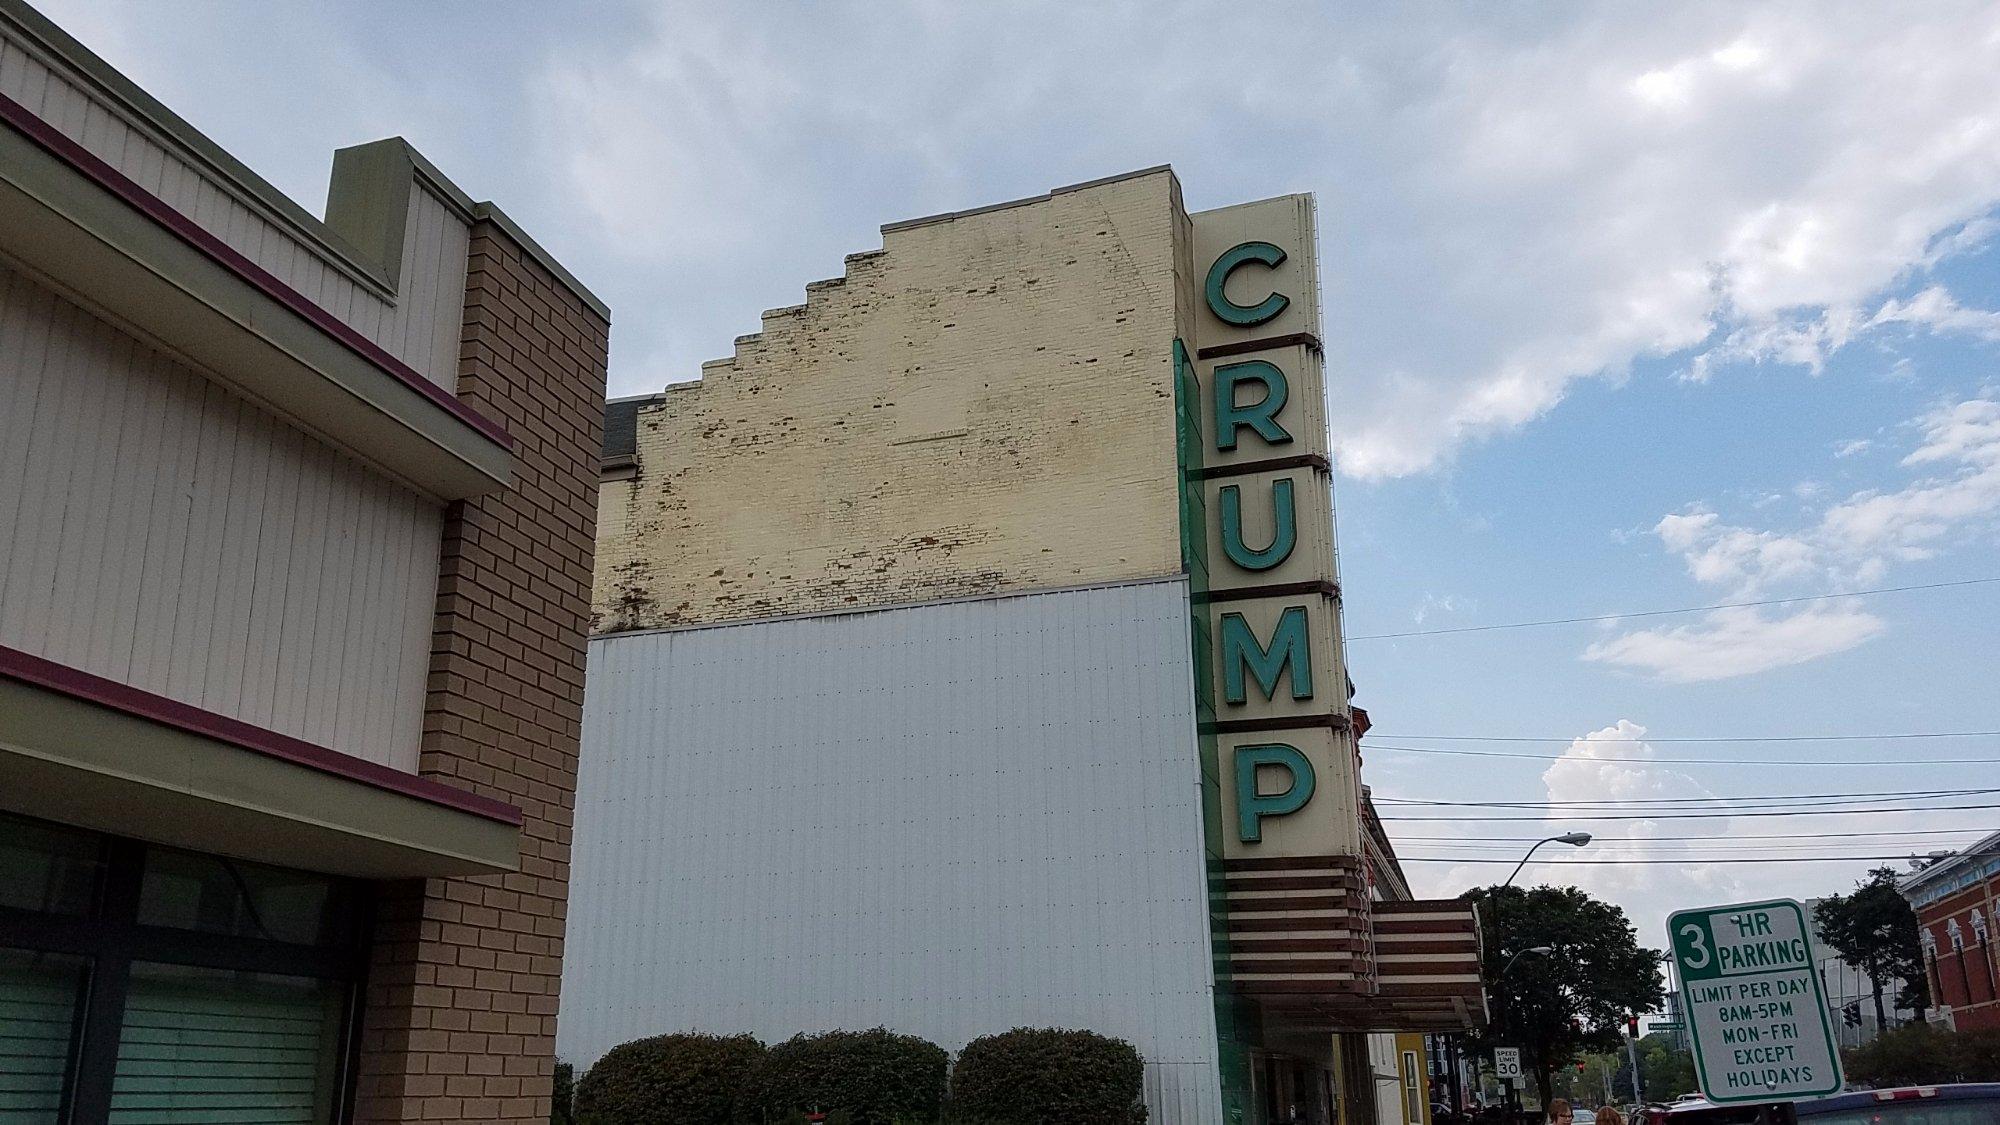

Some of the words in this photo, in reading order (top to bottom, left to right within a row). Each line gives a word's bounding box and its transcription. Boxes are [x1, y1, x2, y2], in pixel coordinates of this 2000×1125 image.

[1205, 241, 1316, 844] CRUMP
[1738, 912, 1772, 937] HR
[1680, 923, 1711, 969] 3
[1718, 938, 1805, 969] PARKING
[1692, 985, 1732, 1004] LIMIT
[1739, 981, 1772, 1000] PER
[1777, 978, 1809, 996] DAY
[1719, 1001, 1793, 1022] 8AM-5PM
[1722, 1023, 1798, 1044] MON-FRI
[1734, 1045, 1794, 1065] EXCEPT
[1499, 1063, 1518, 1074] 30
[1727, 1066, 1813, 1088] HOLIDAYS
